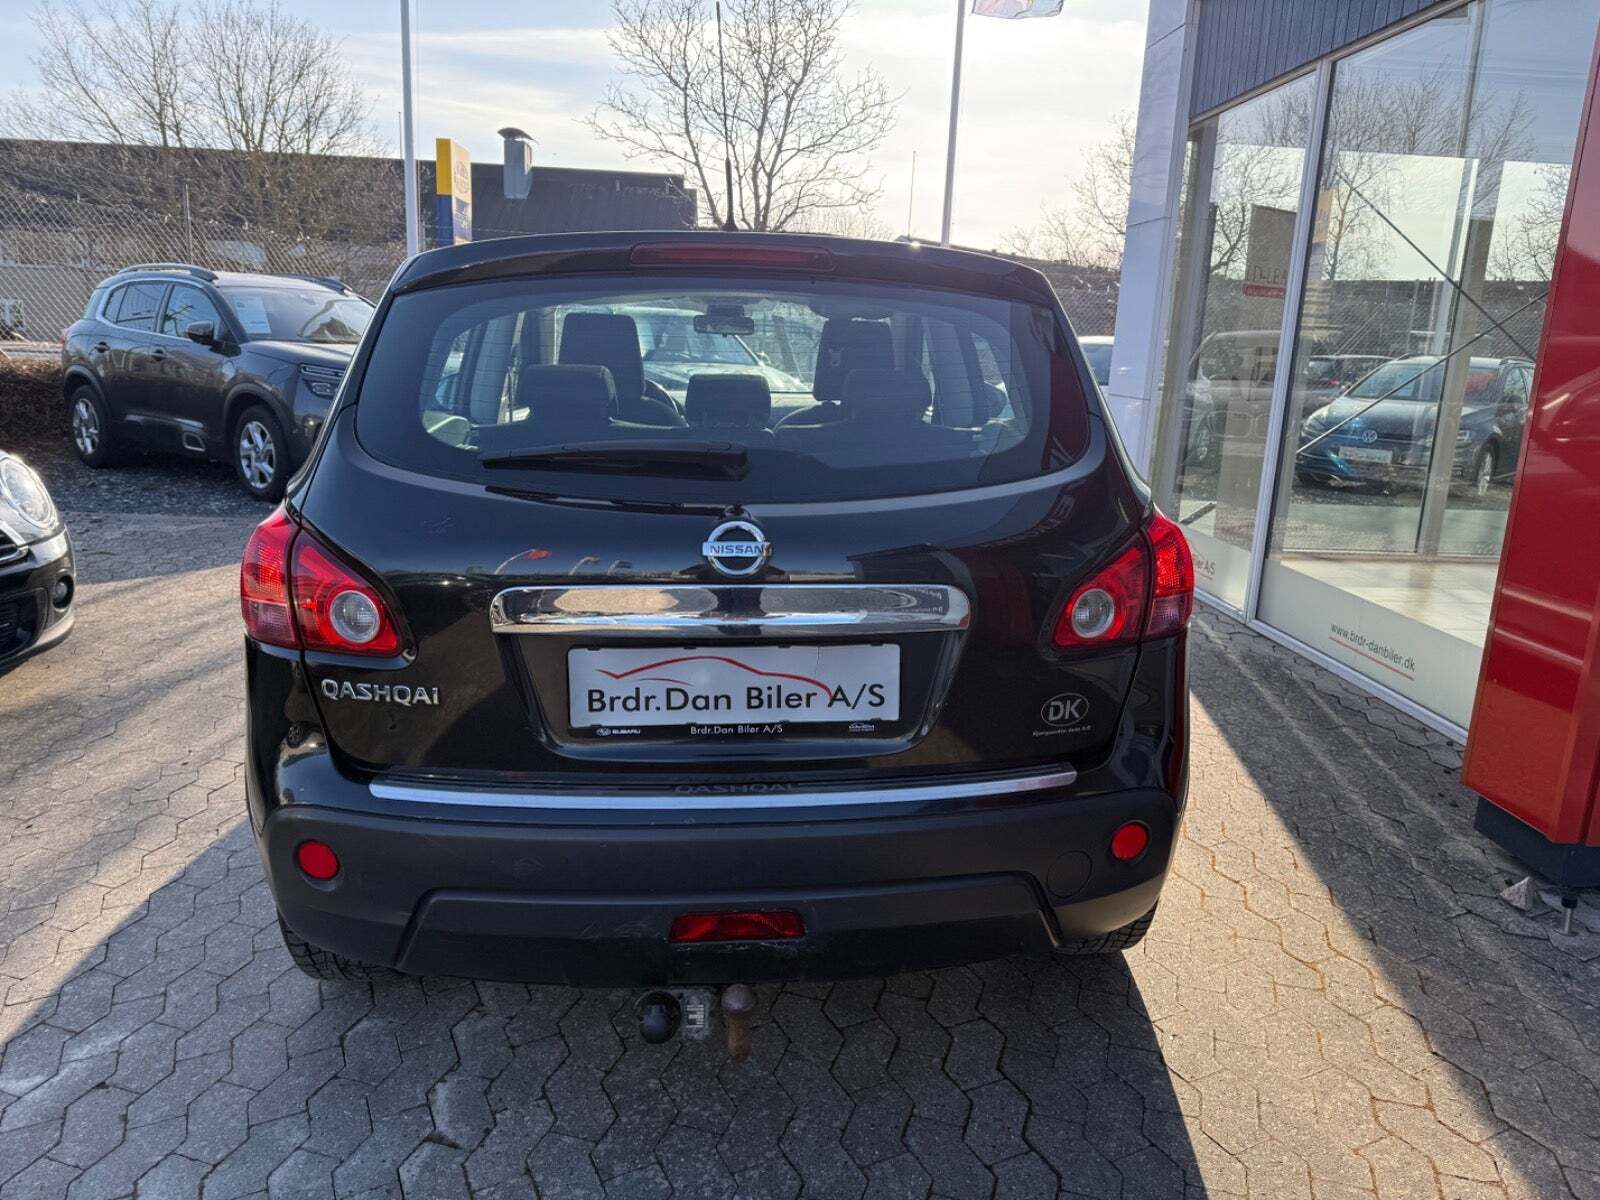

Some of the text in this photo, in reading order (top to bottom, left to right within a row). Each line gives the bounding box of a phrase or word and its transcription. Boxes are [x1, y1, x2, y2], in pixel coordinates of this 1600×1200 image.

[710, 544, 763, 554] NISSAN
[1330, 623, 1416, 672] www.brdr-danbiler.dk
[321, 679, 439, 706] QASHQAI
[587, 683, 886, 713] Brdr.Dan Biler A/S
[1048, 698, 1082, 721] DK
[690, 724, 783, 735] Brdr.Dan Biler A/S
[674, 782, 798, 794] QASHQAI
